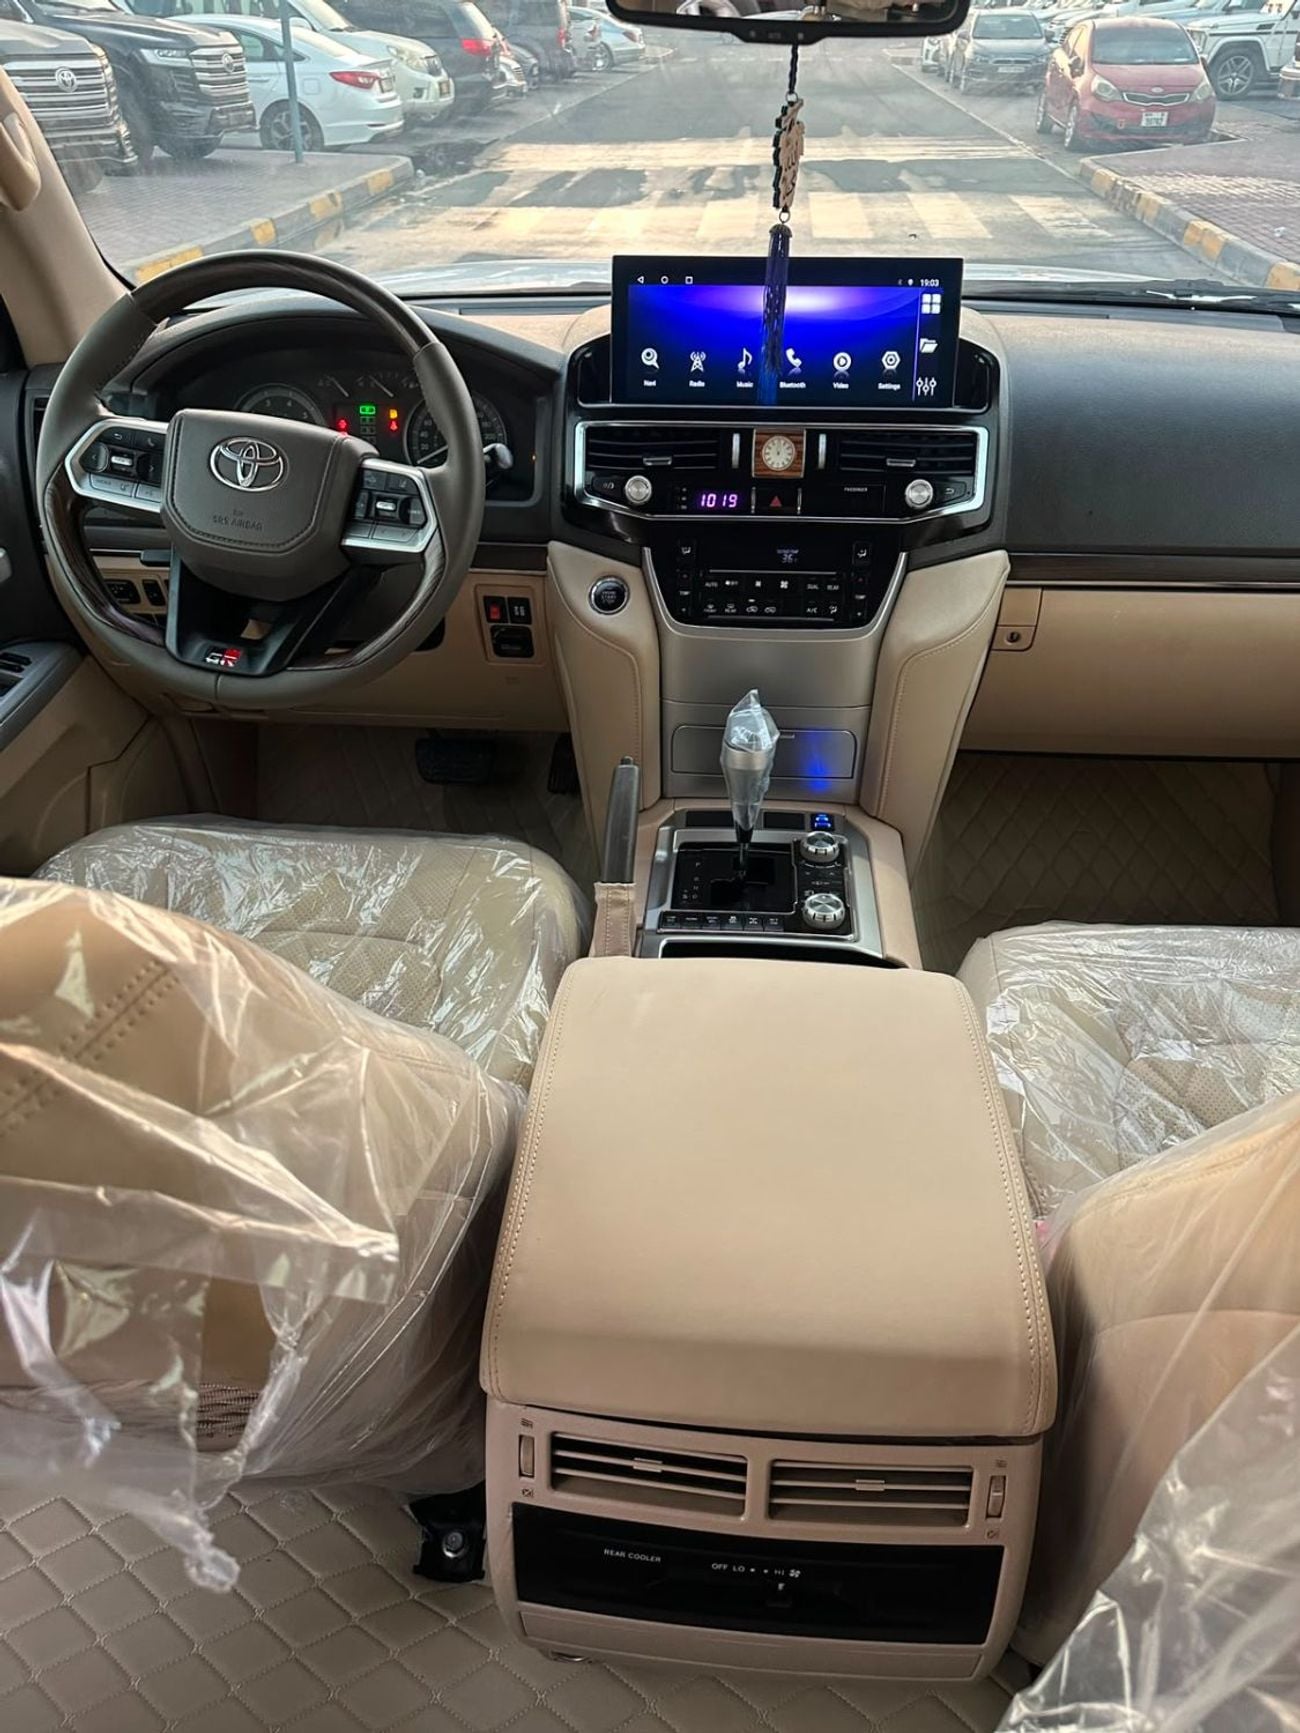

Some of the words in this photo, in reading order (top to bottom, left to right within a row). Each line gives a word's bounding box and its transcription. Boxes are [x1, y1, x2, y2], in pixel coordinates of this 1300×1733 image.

[920, 279, 940, 287] 19:03
[779, 381, 807, 389] Bluetooth
[877, 382, 901, 391] Settings
[206, 650, 239, 667] GR
[604, 1548, 626, 1559] REAR
[628, 1552, 662, 1563] COOLER
[711, 1563, 729, 1571] OFF
[733, 1565, 746, 1573] LO
